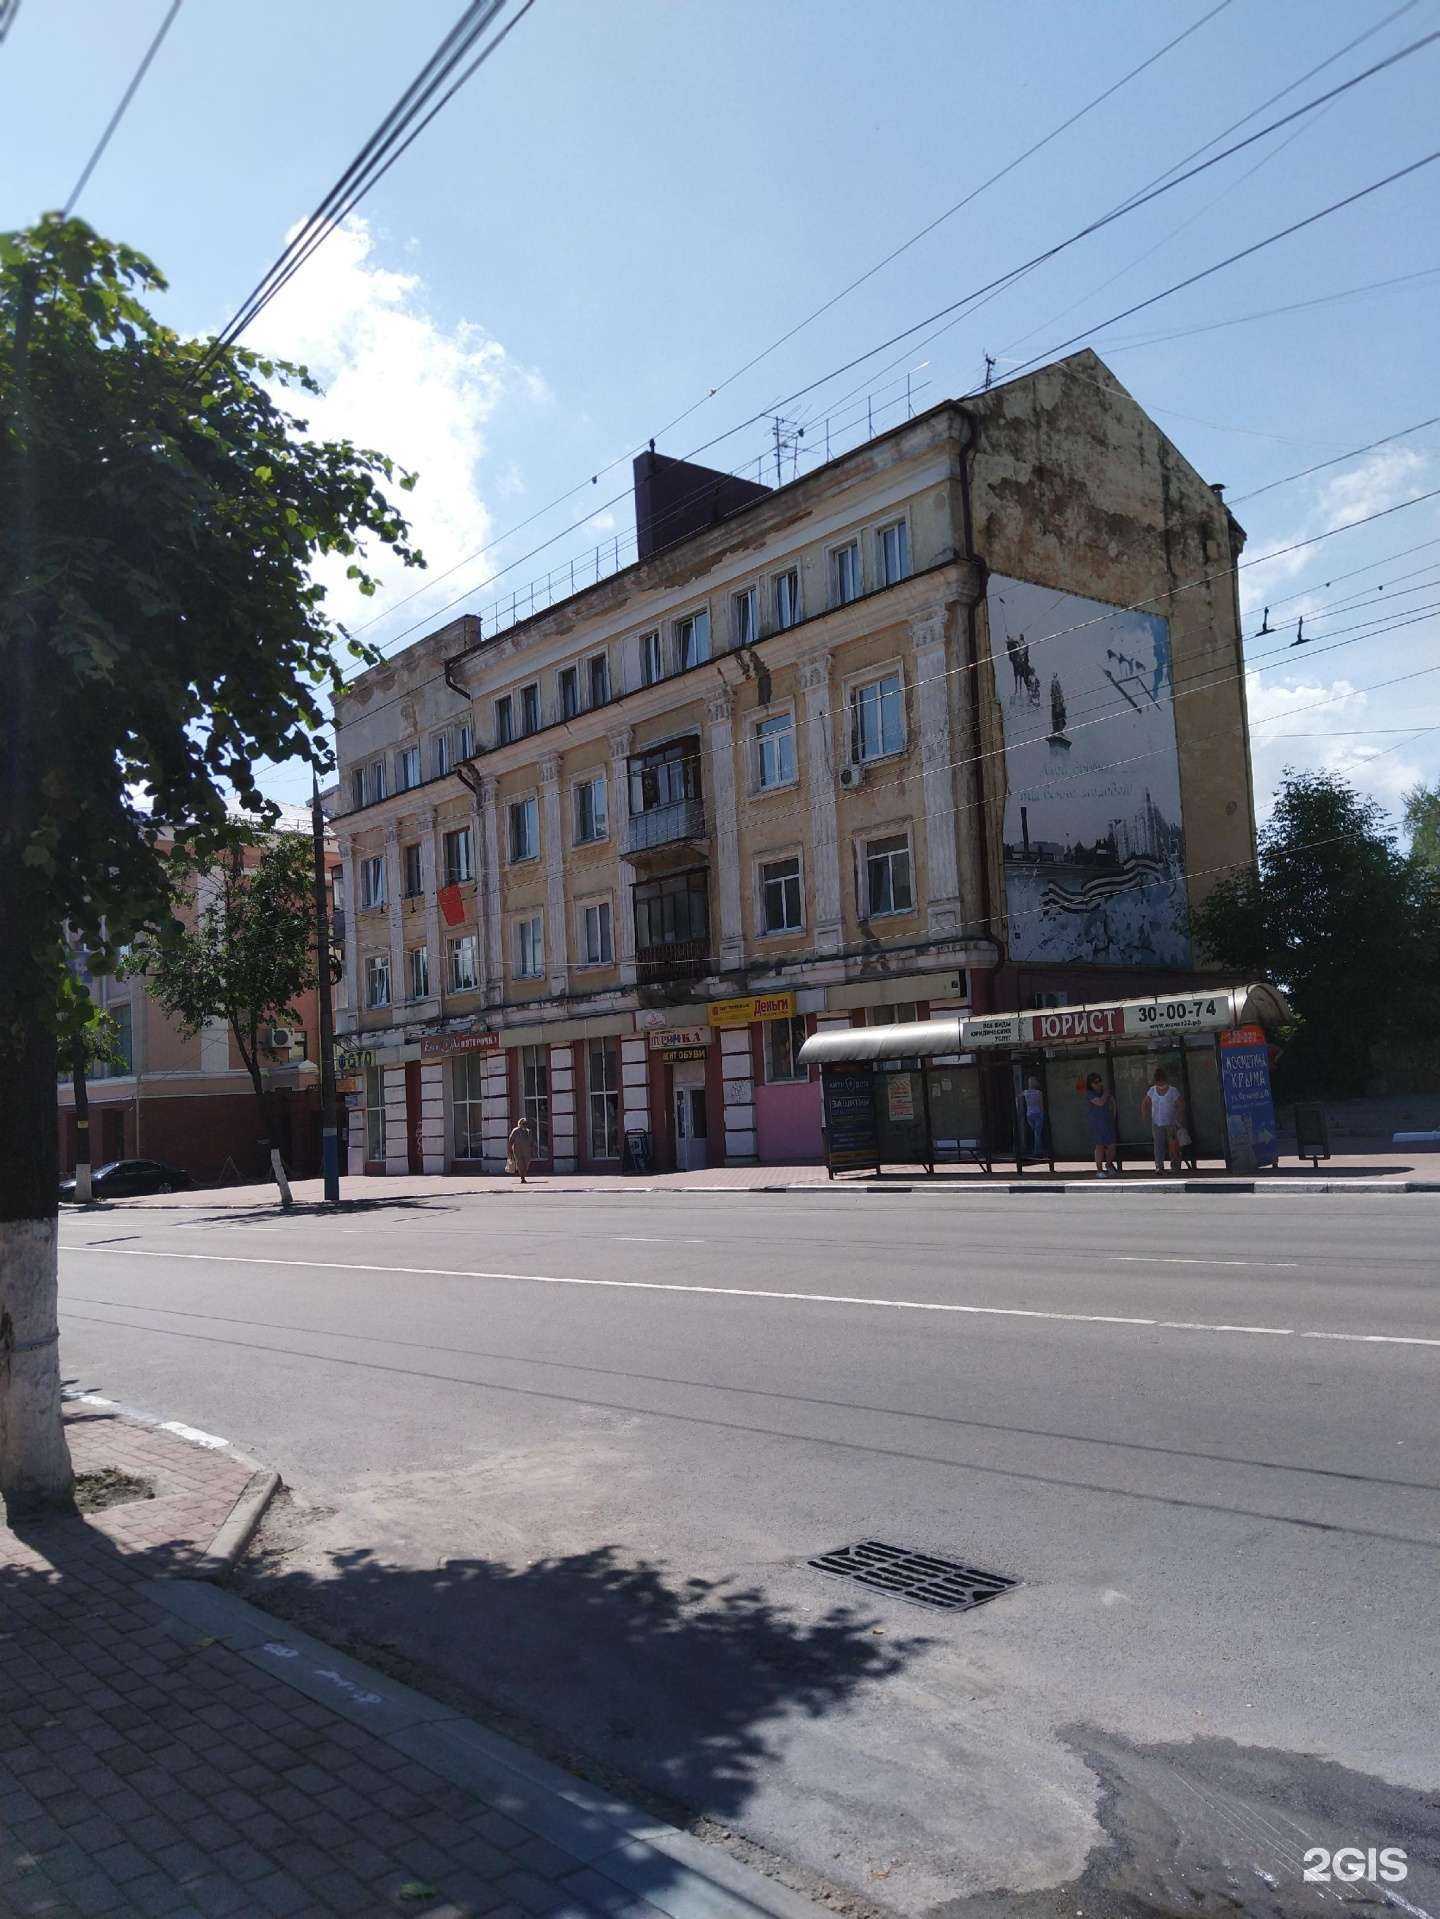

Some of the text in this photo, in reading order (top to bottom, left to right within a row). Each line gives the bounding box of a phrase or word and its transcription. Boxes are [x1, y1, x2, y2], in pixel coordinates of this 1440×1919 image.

[753, 999, 789, 1016] Деньги
[1139, 1000, 1216, 1022] 30-00-74
[1040, 1010, 1116, 1038] ЮРИСТ
[679, 1050, 705, 1059] ОБУВИ
[1232, 1071, 1265, 1088] КРЫМА
